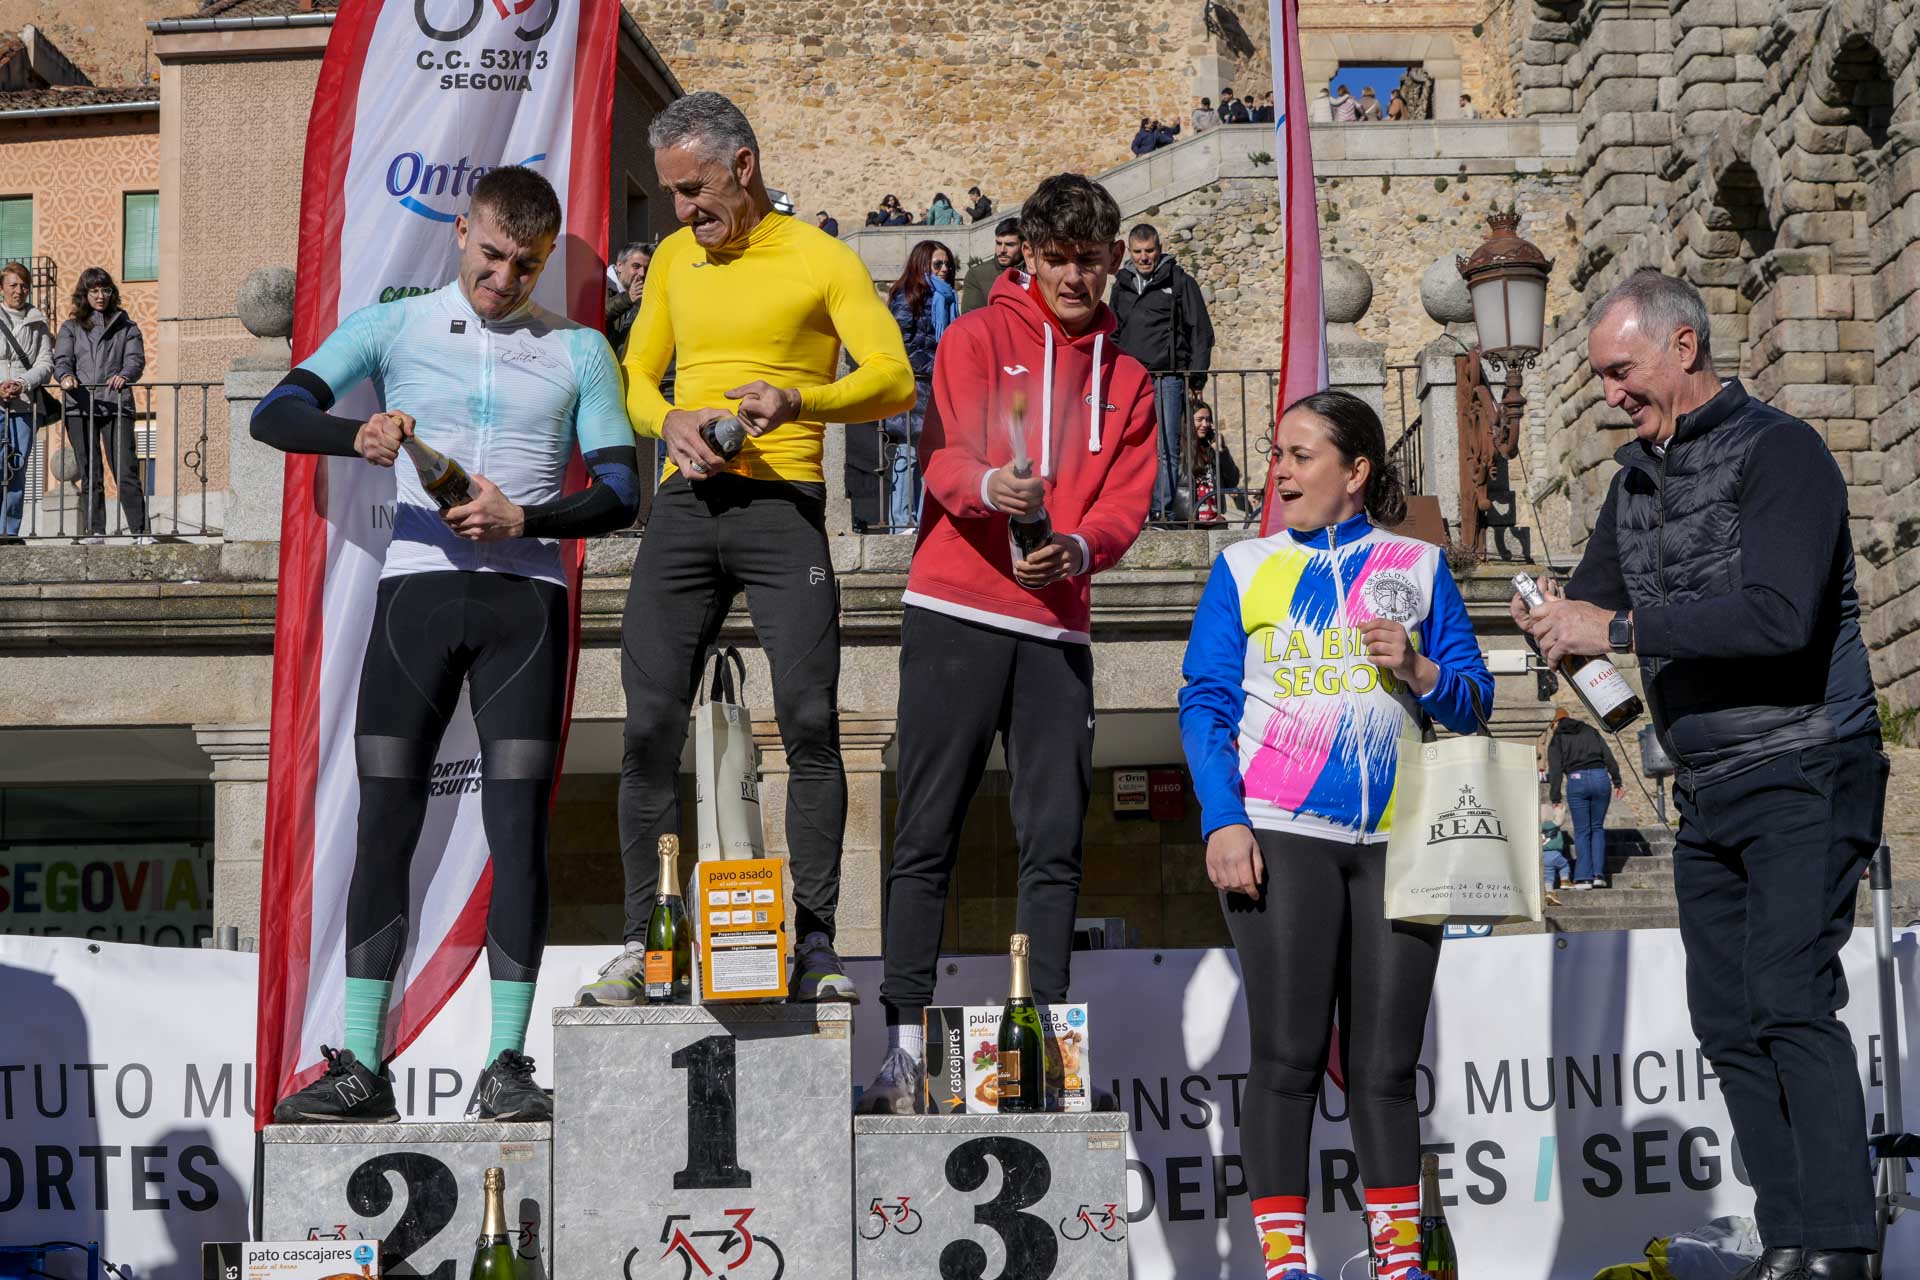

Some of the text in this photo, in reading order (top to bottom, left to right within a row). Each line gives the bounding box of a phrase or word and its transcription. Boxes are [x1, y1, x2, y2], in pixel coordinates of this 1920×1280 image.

[416, 49, 548, 70] C.C. 53X13
[440, 73, 532, 92] SEGOVIA
[1264, 630, 1311, 663] LA
[1430, 818, 1507, 841] REAL
[709, 867, 773, 885] pavo asado
[947, 1028, 964, 1093] cascajares
[672, 1035, 751, 1189] 1
[347, 1152, 458, 1280] 2
[938, 1136, 1058, 1280] 3
[249, 1249, 280, 1264] pato
[282, 1247, 352, 1263] cascajares
